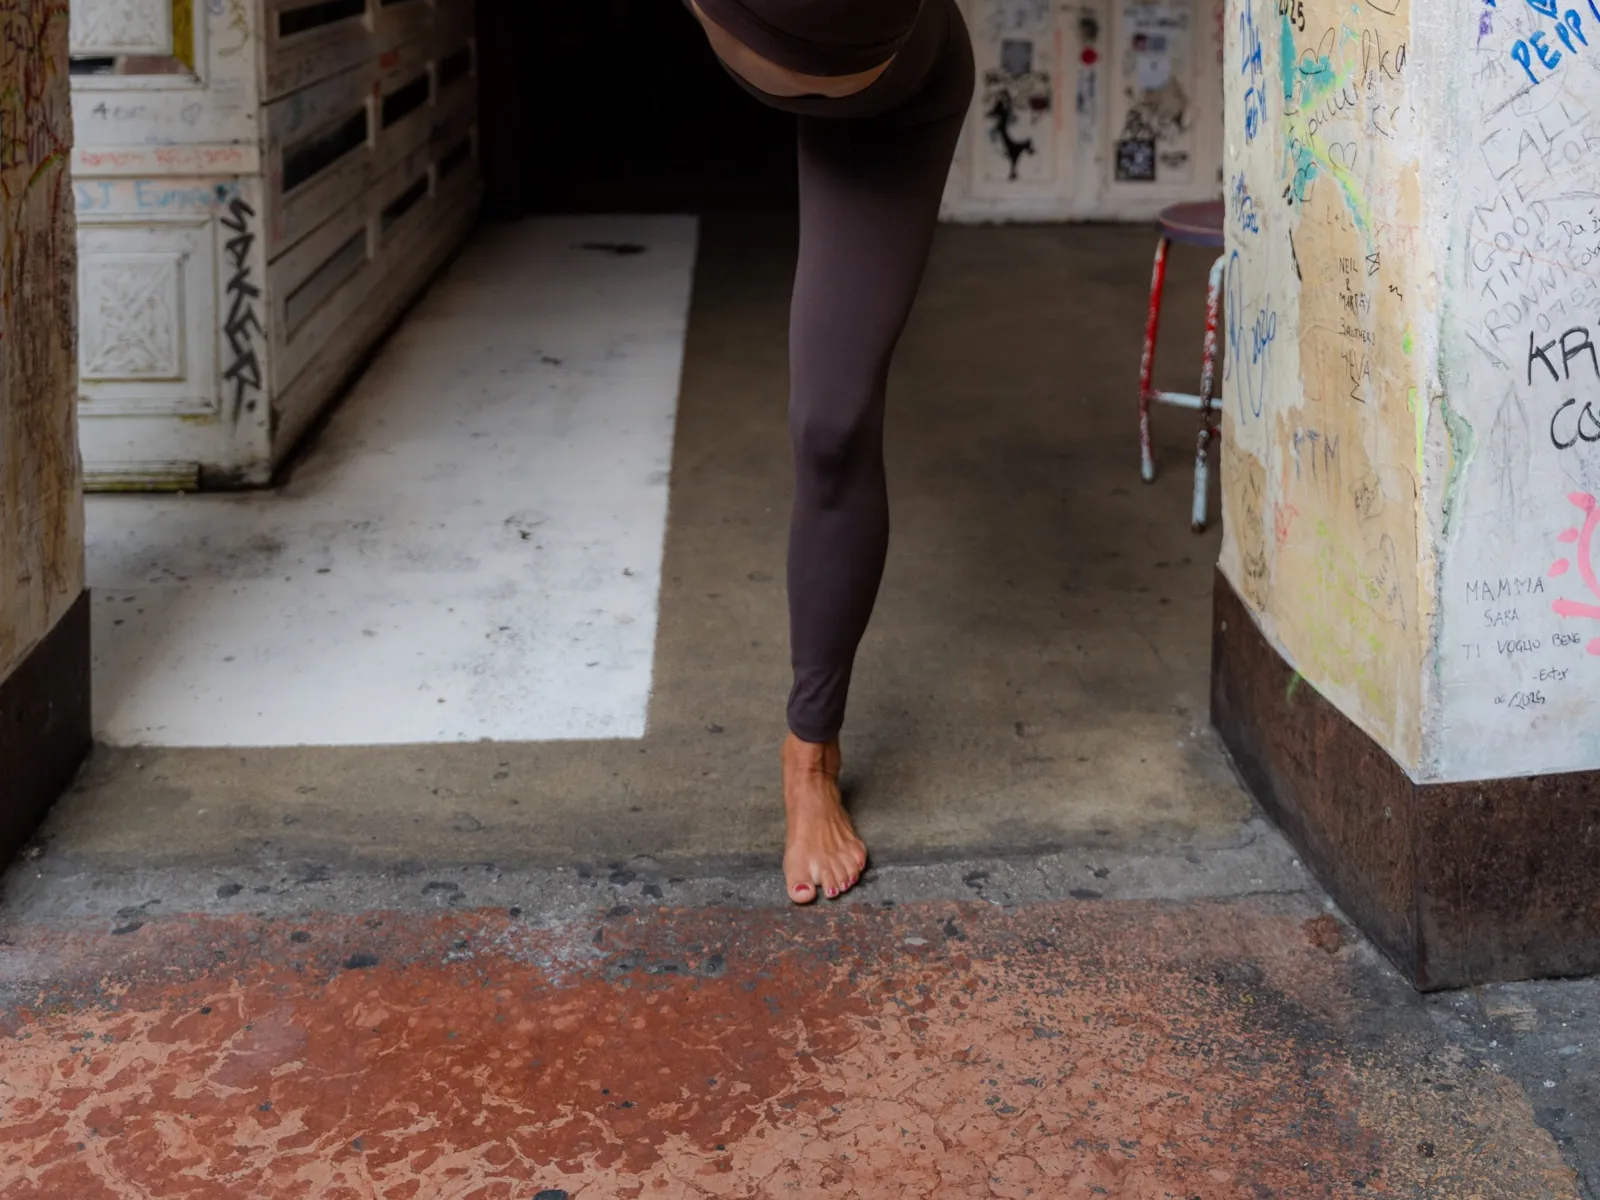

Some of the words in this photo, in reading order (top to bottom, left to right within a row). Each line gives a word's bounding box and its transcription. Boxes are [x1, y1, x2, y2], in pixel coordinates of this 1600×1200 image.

[1473, 200, 1550, 273] GOOD
[1338, 257, 1360, 275] NEIL
[1465, 576, 1544, 605] MAMMA
[1484, 608, 1520, 628] SARA
[1461, 644, 1480, 660] TI
[1496, 639, 1541, 654] VOGLIO
[1551, 632, 1580, 647] BENE
